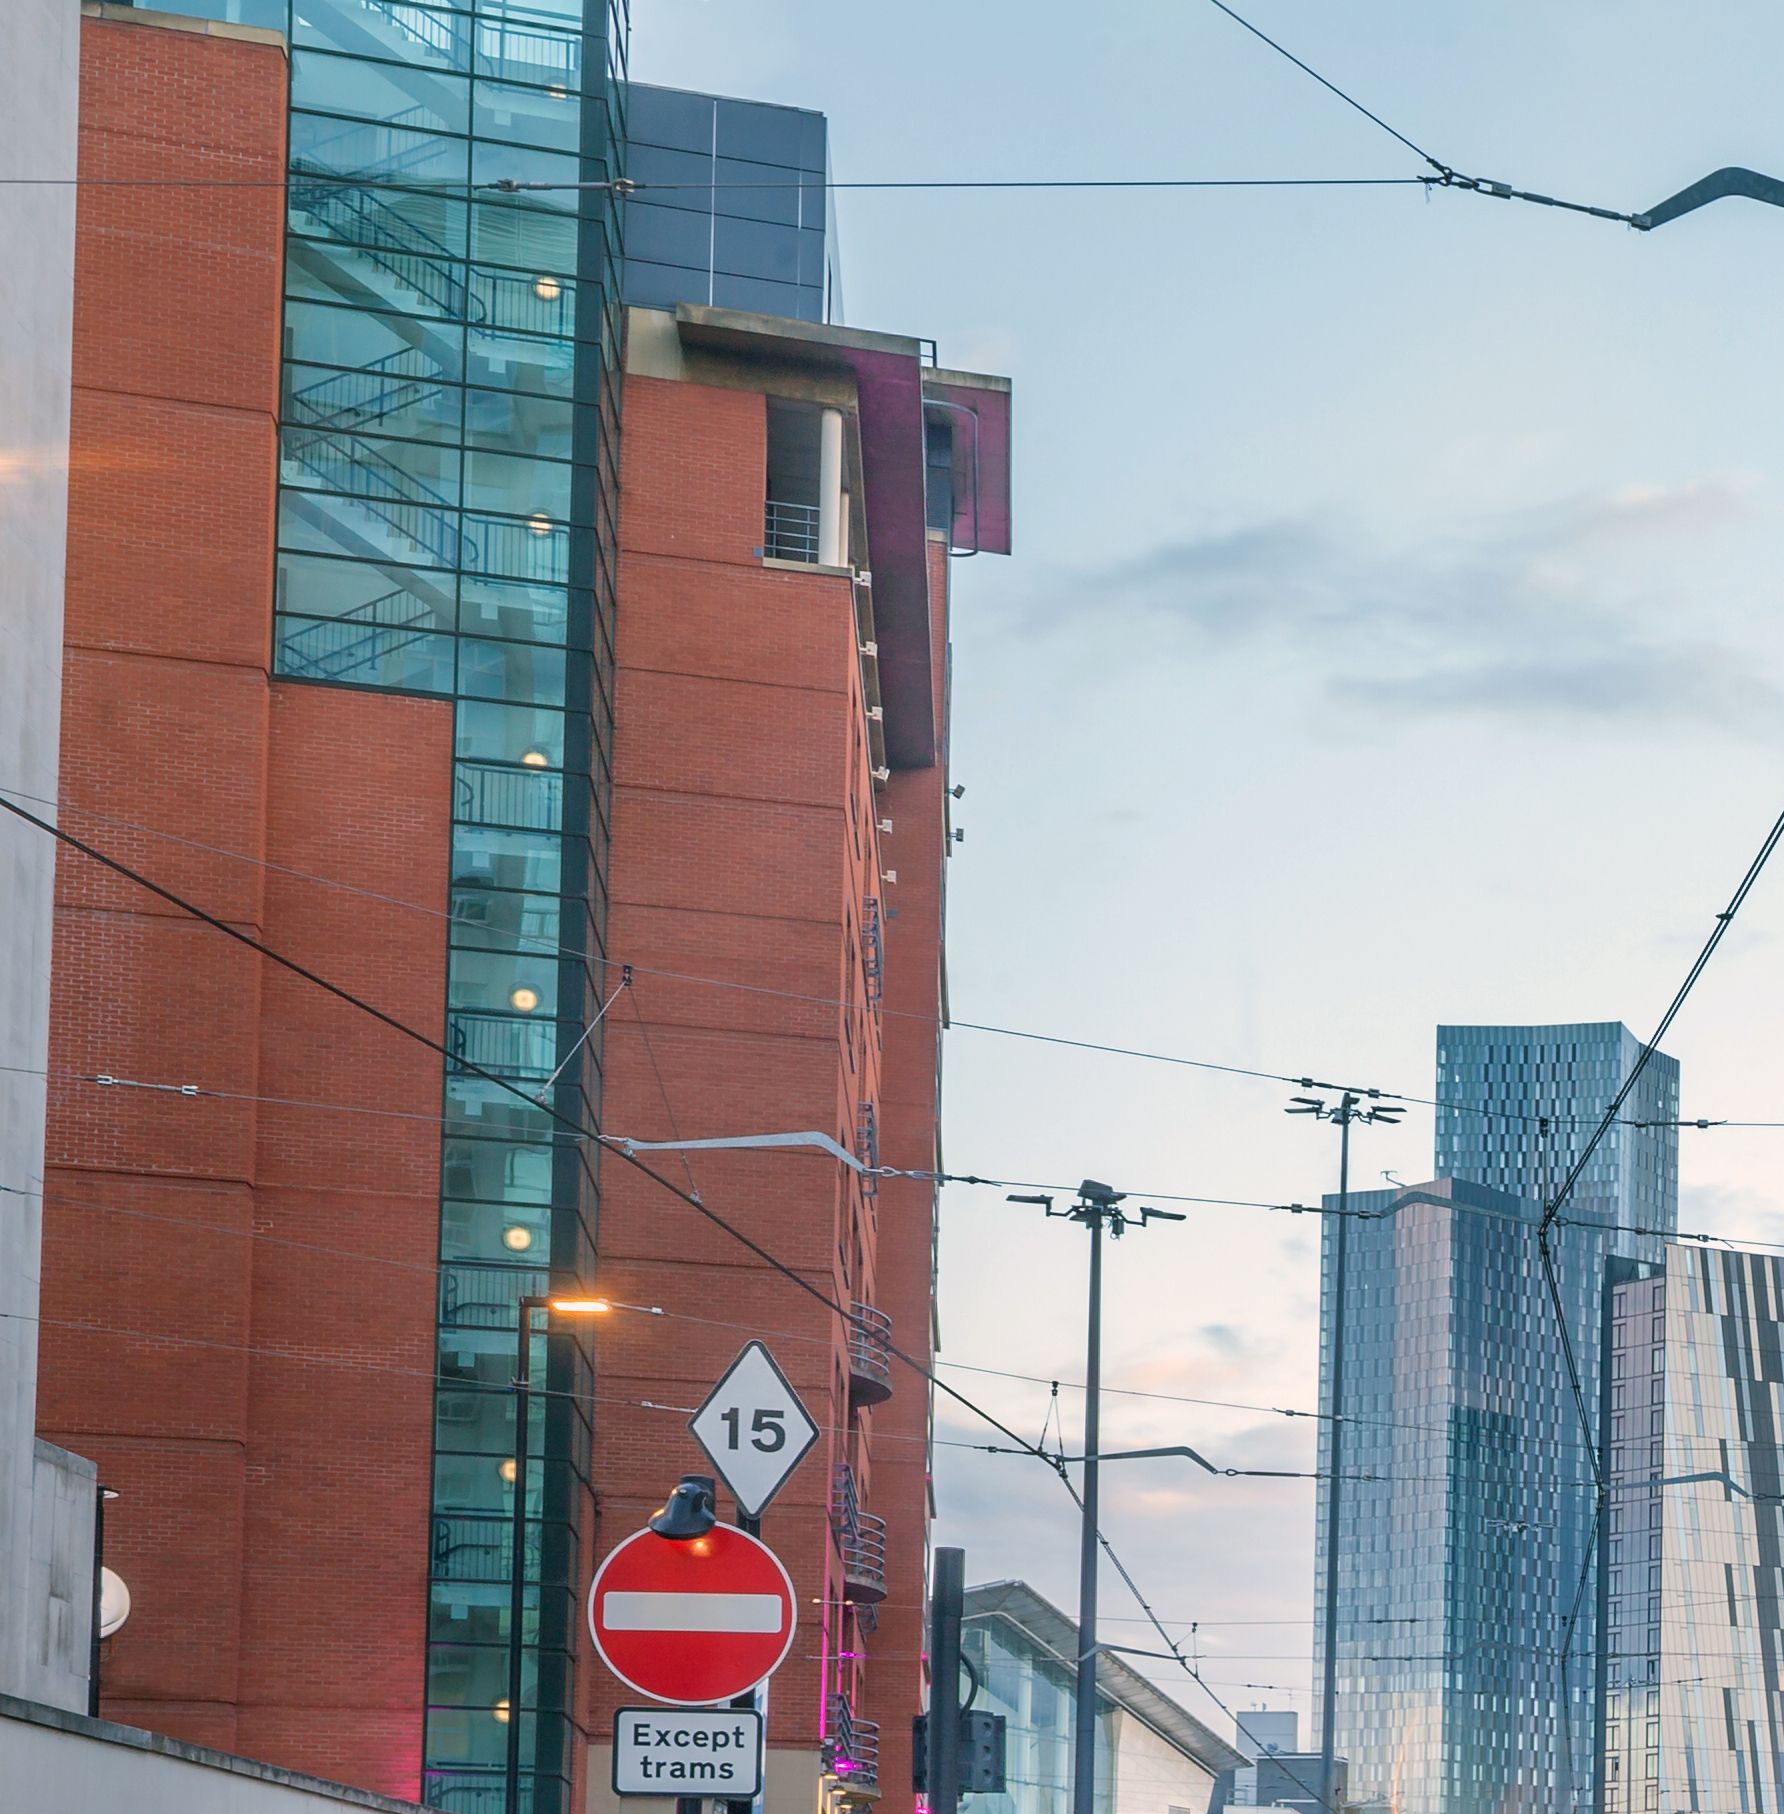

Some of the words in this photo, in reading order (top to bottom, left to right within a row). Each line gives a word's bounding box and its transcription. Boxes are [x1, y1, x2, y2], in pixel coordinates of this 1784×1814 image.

[721, 1407, 786, 1453] 15
[633, 1723, 745, 1752] Except
[640, 1755, 734, 1779] trams
